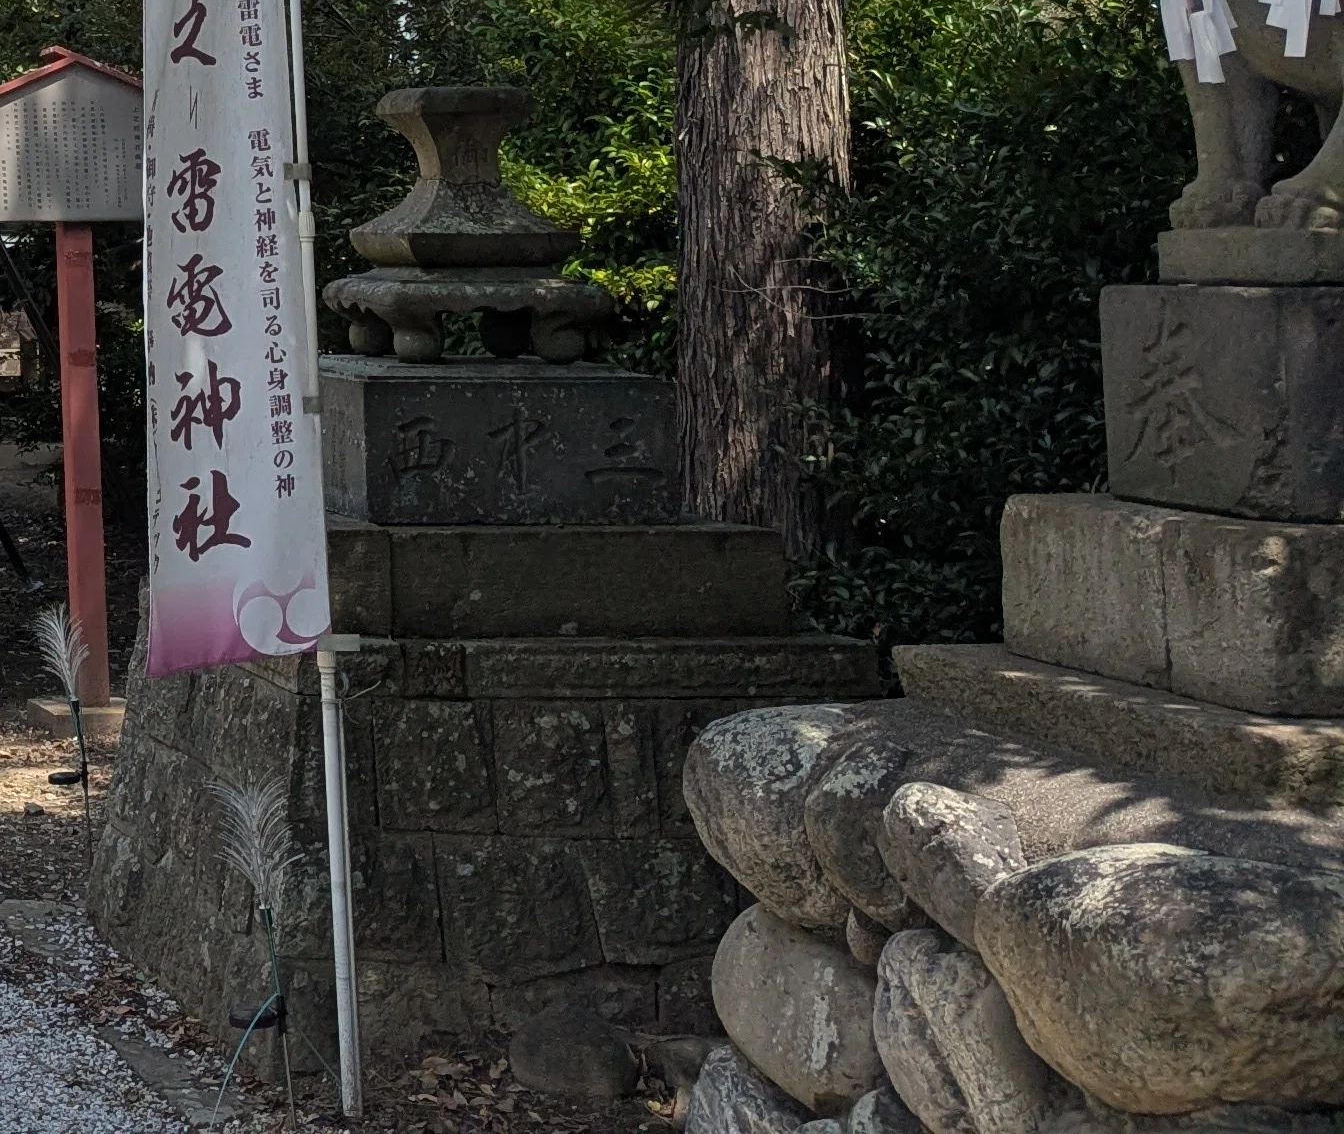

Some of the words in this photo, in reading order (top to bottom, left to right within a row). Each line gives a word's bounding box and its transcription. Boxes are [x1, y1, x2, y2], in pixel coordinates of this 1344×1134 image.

[248, 128, 296, 499] 電気と神経を司る心身調整の神
